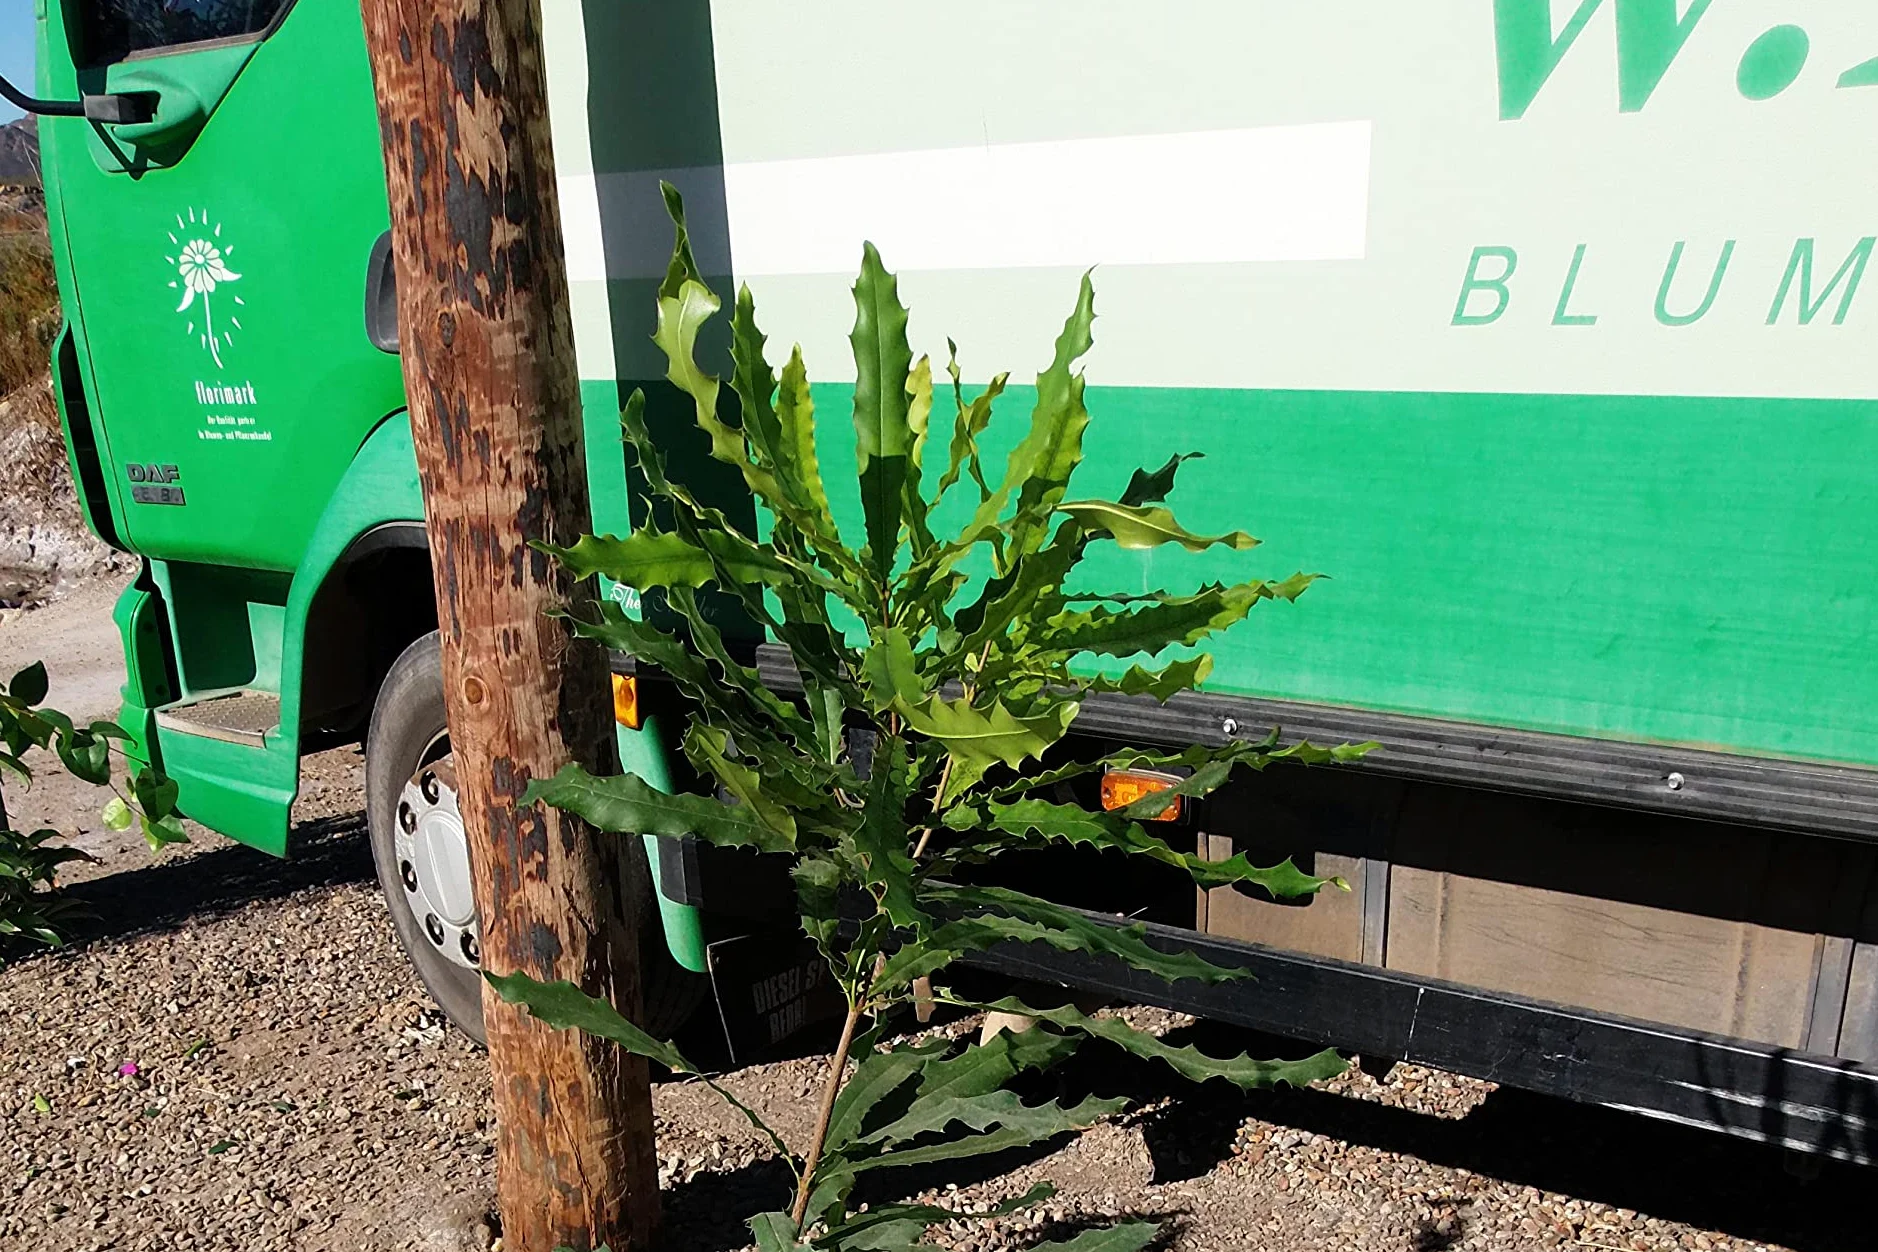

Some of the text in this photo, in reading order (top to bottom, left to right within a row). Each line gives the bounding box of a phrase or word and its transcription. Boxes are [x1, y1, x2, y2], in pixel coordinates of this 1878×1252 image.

[1451, 236, 1878, 327] BLUM
[126, 464, 180, 483] DAF
[752, 965, 801, 1014] DIESEL
